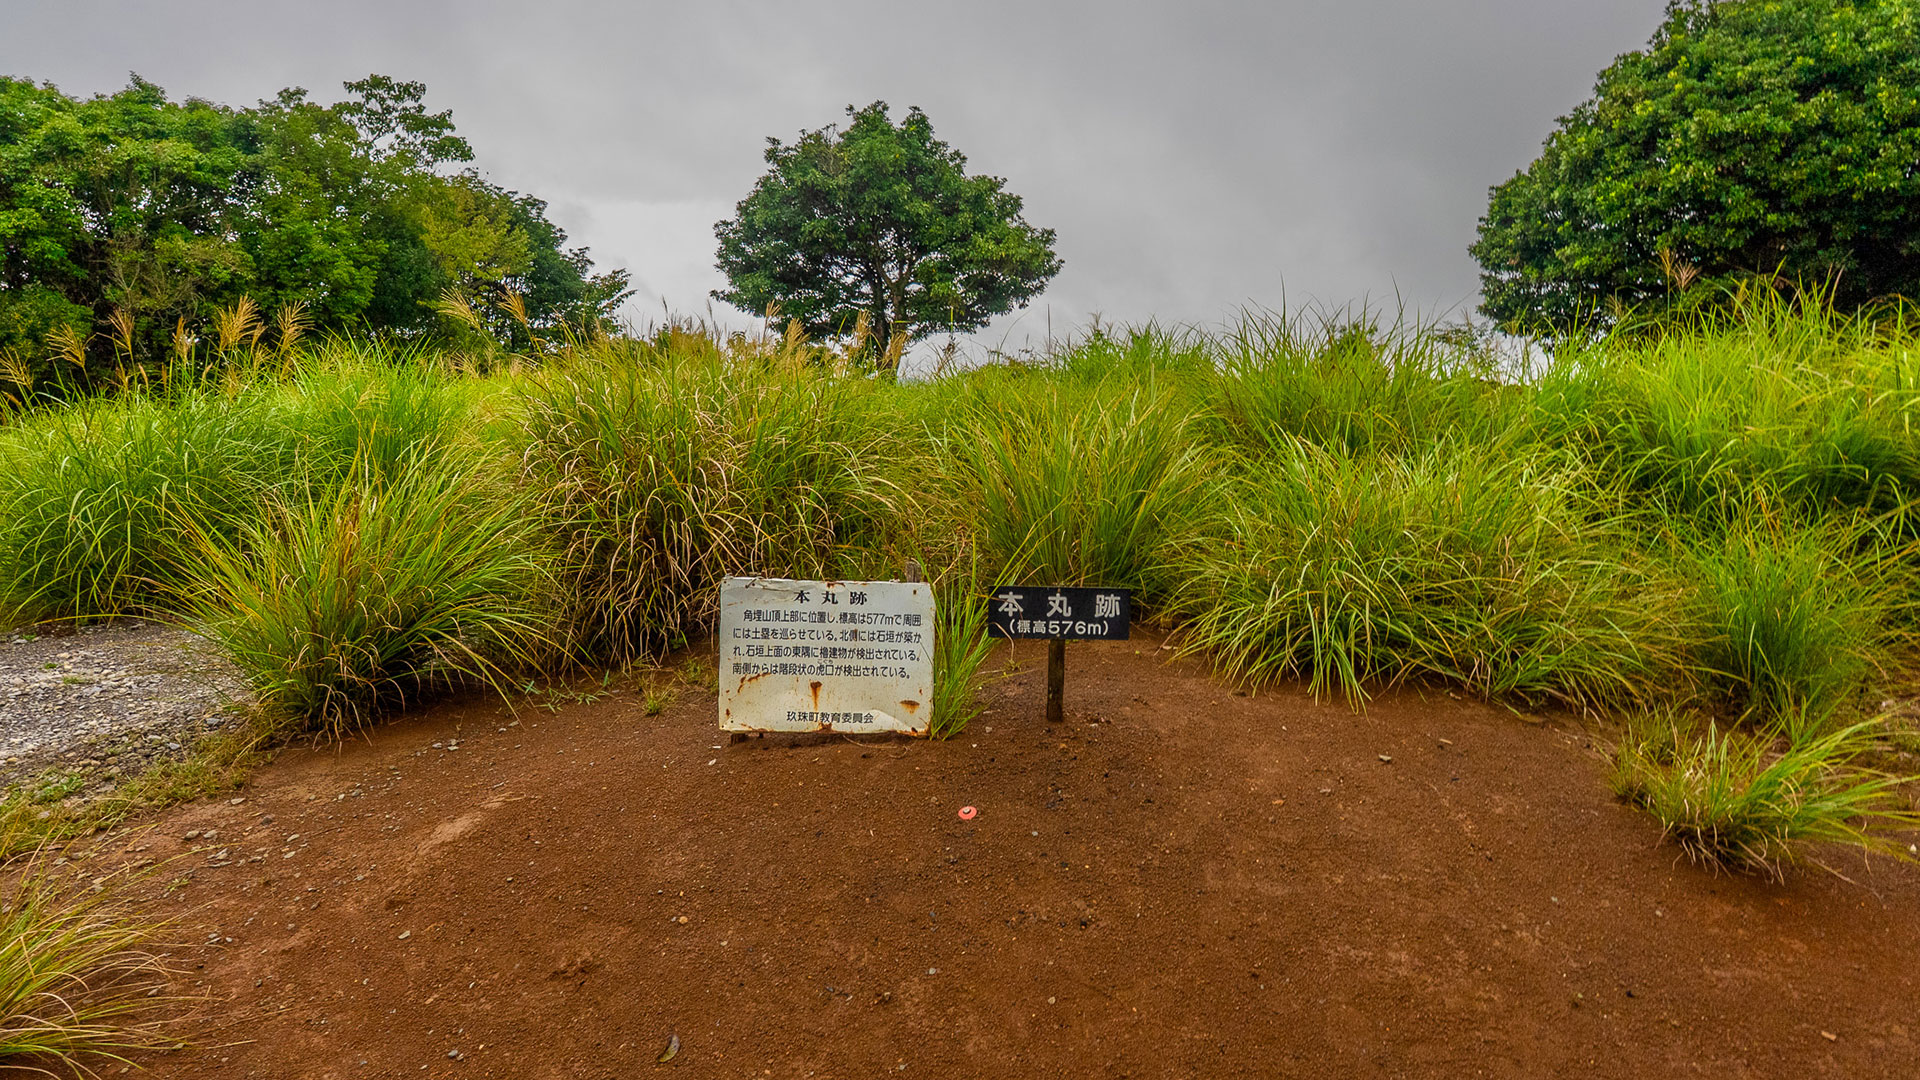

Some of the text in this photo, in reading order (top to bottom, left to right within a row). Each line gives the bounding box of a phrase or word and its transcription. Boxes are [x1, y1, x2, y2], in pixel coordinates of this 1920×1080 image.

[793, 590, 868, 605] 本丸跡
[998, 591, 1121, 618] 本丸跡
[786, 710, 874, 724] 玖珠町教育委員会
